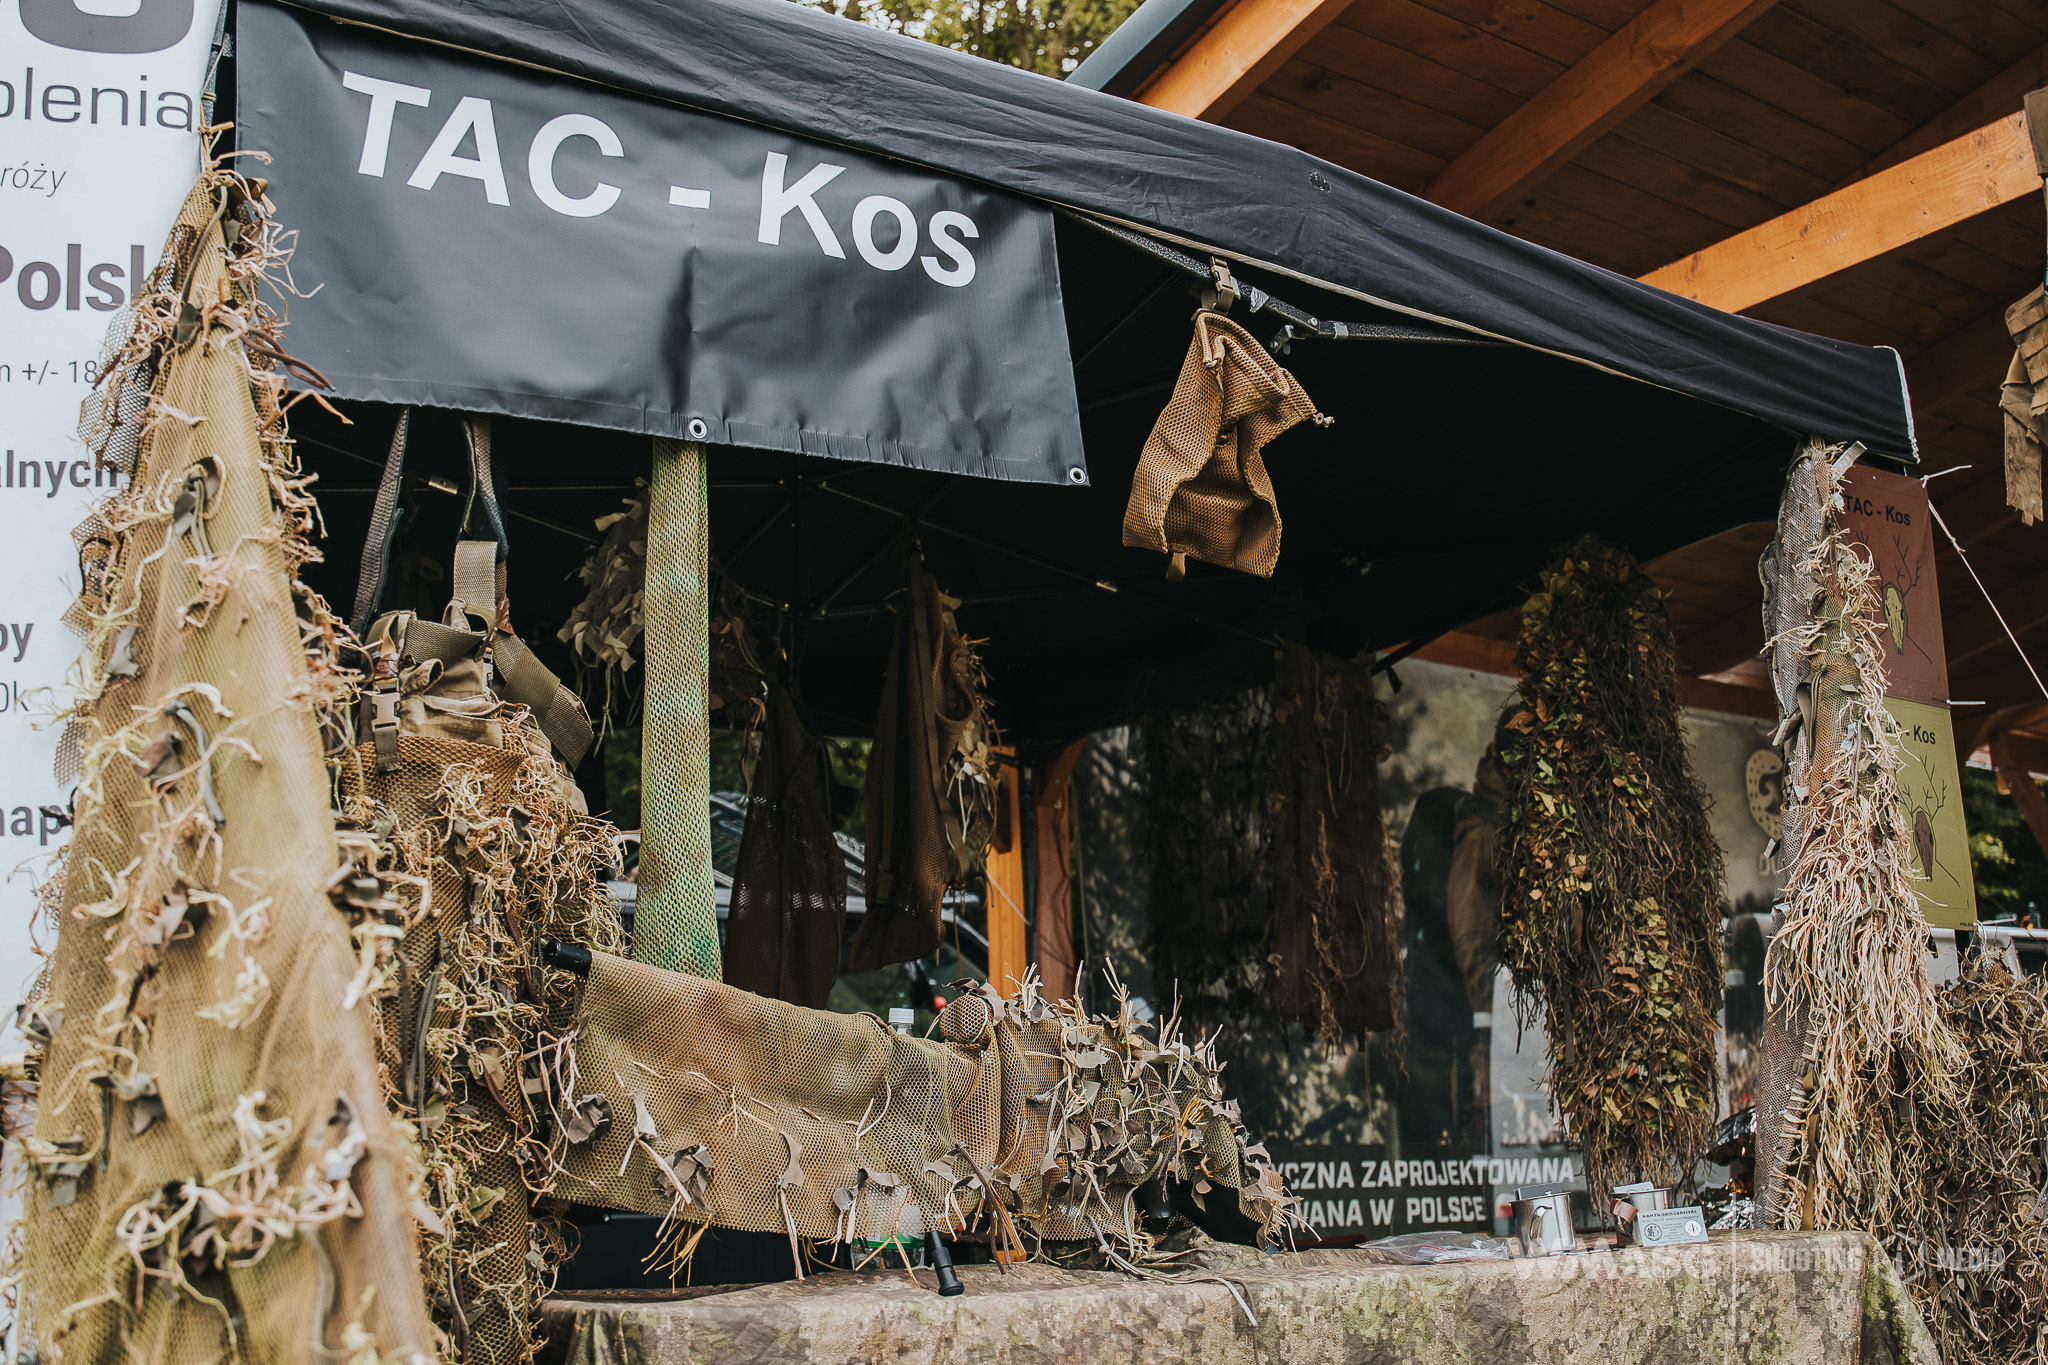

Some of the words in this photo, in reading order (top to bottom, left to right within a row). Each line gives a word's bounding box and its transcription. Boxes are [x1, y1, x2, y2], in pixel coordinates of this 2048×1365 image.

[1, 161, 66, 197] róży
[342, 70, 624, 218] TAC
[669, 186, 711, 210] -
[757, 151, 980, 287] Kos
[0, 449, 118, 498] lnyc
[1844, 494, 1873, 517] TAC
[1885, 504, 1911, 526] Kos
[1913, 724, 1936, 745] Kos
[0, 804, 65, 846] ap
[1361, 1157, 1574, 1188] ZAPROJEKTOWANA
[1369, 1198, 1394, 1226] W
[1406, 1195, 1487, 1225] POLSCE
